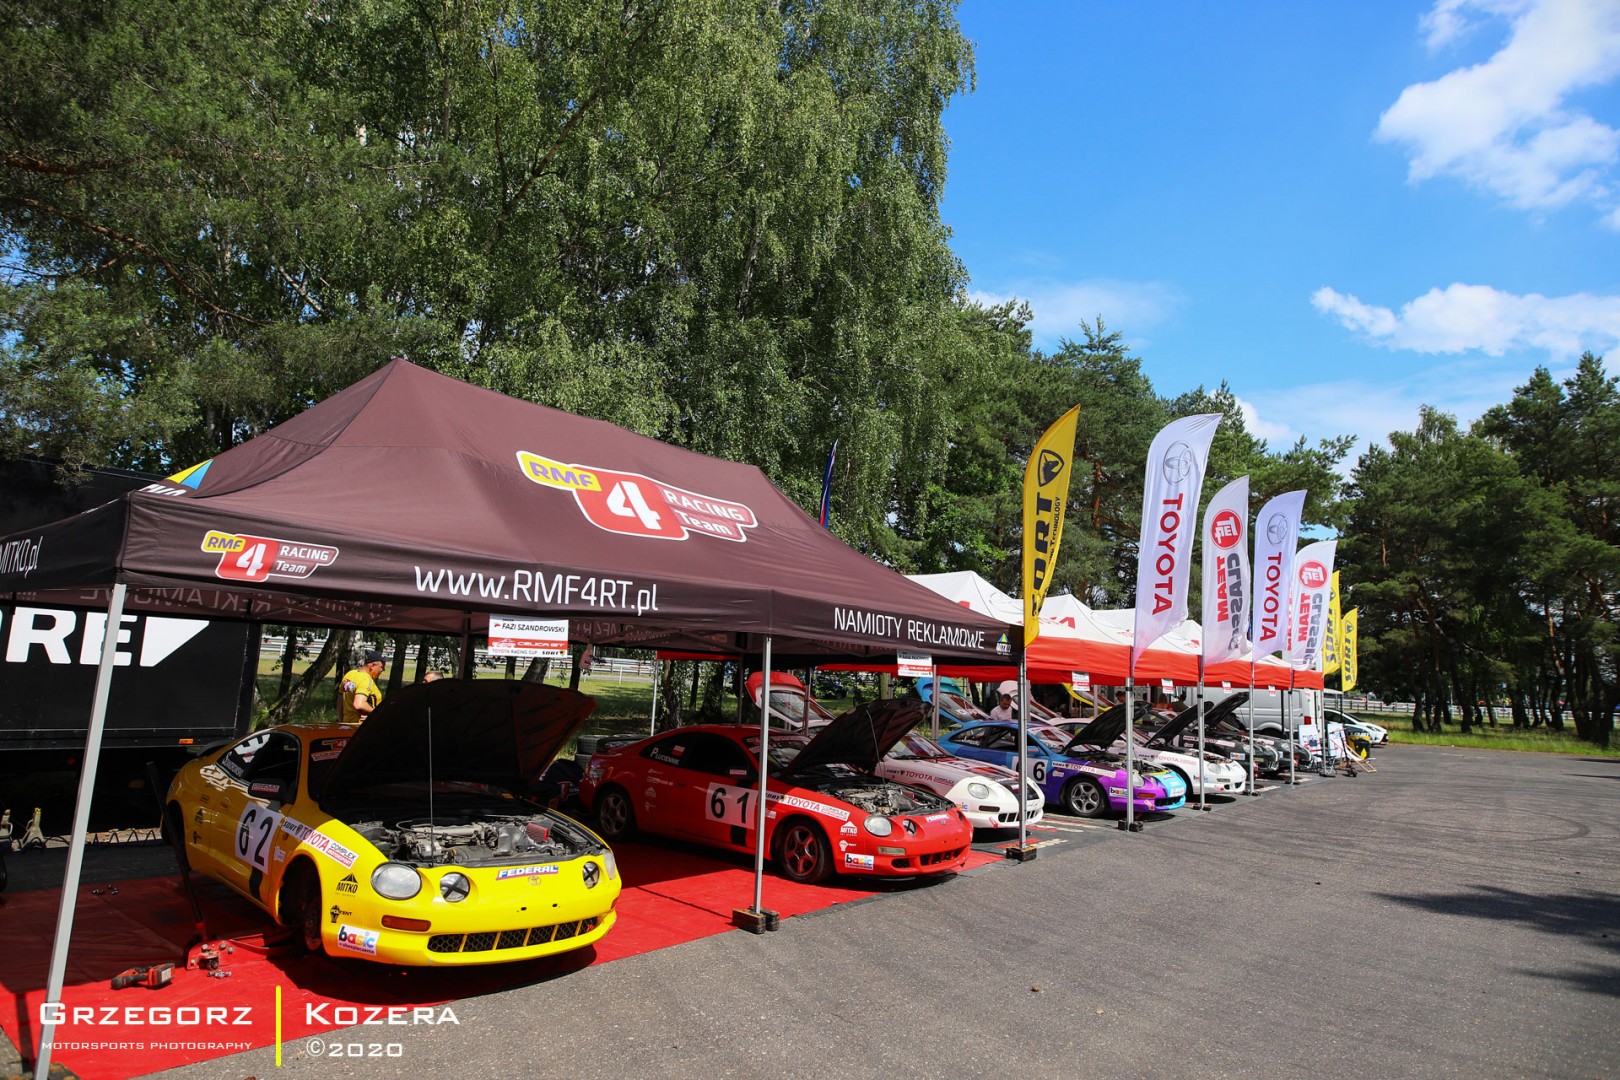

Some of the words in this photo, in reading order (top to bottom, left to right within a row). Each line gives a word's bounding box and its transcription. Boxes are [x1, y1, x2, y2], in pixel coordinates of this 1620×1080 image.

[529, 461, 592, 487] RMF
[607, 481, 661, 530] 4
[667, 490, 743, 521] RACING
[681, 512, 733, 535] Team
[208, 536, 243, 550] RMF
[280, 545, 329, 562] RACING
[1152, 493, 1184, 616] TOYOTA
[236, 543, 266, 577] 4
[276, 560, 307, 574] Team
[414, 566, 659, 616] www.RMF4RT.pl
[1259, 552, 1283, 642] TOYOTA
[0, 606, 138, 667] RE
[518, 624, 565, 633] SZANDROWSKI
[834, 607, 902, 638] NAMIOTY
[908, 620, 985, 650] REKLAMOWE
[905, 770, 933, 781] TOYOTA
[1070, 764, 1095, 773] TOYOTA
[711, 787, 750, 824] 61
[787, 797, 820, 811] TOYOTA
[239, 809, 273, 867] 62
[300, 827, 330, 852] TOYOTA
[330, 842, 357, 860] COMPLEX
[846, 854, 873, 866] basic
[499, 866, 558, 878] FEDERAL
[336, 882, 359, 894] MITKO
[338, 926, 375, 948] basic
